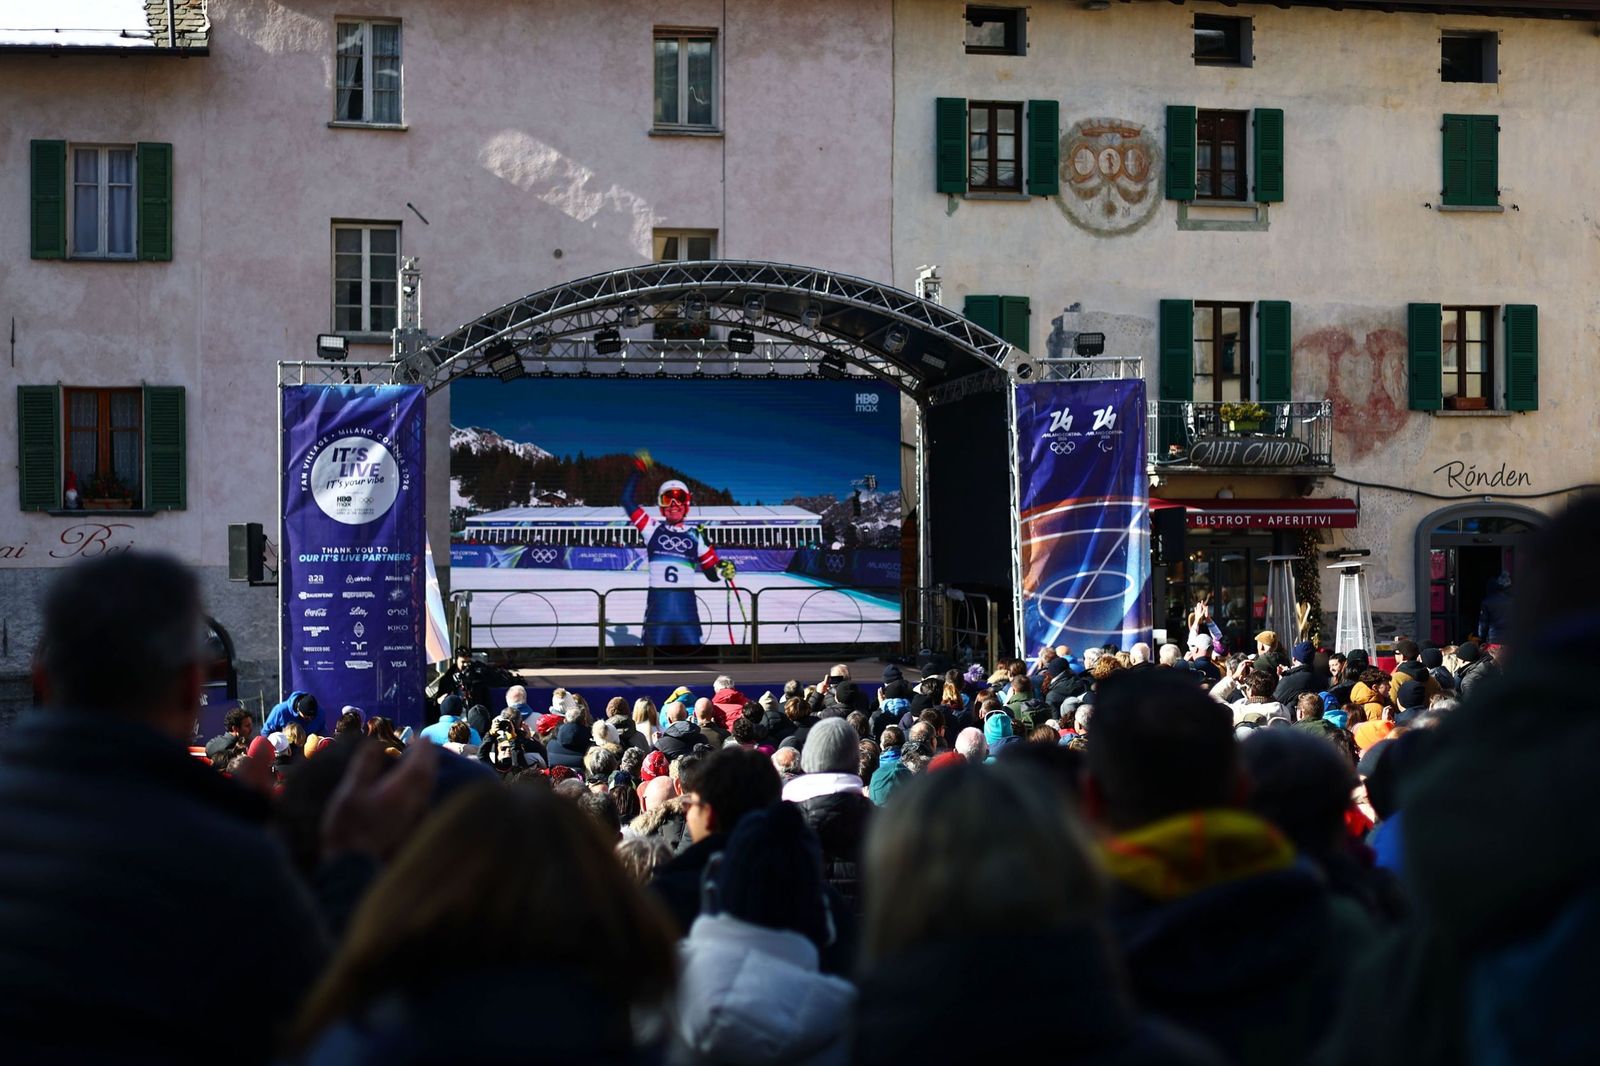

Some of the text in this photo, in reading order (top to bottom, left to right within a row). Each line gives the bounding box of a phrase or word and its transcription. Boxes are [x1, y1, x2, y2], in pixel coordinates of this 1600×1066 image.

[856, 393, 879, 404] HBO
[338, 428, 373, 436] MILANO
[303, 437, 328, 469] VILLAGE
[332, 448, 368, 462] IT'S
[1242, 441, 1309, 464] CAVOUR
[340, 463, 380, 478] LIVE
[1433, 460, 1532, 492] Rónden
[344, 478, 366, 489] your
[367, 474, 384, 484] vibe
[1196, 516, 1331, 525] BISTROT APERITIVI
[362, 553, 411, 561] PARTNERS
[664, 566, 678, 583] 6
[387, 607, 408, 616] enel
